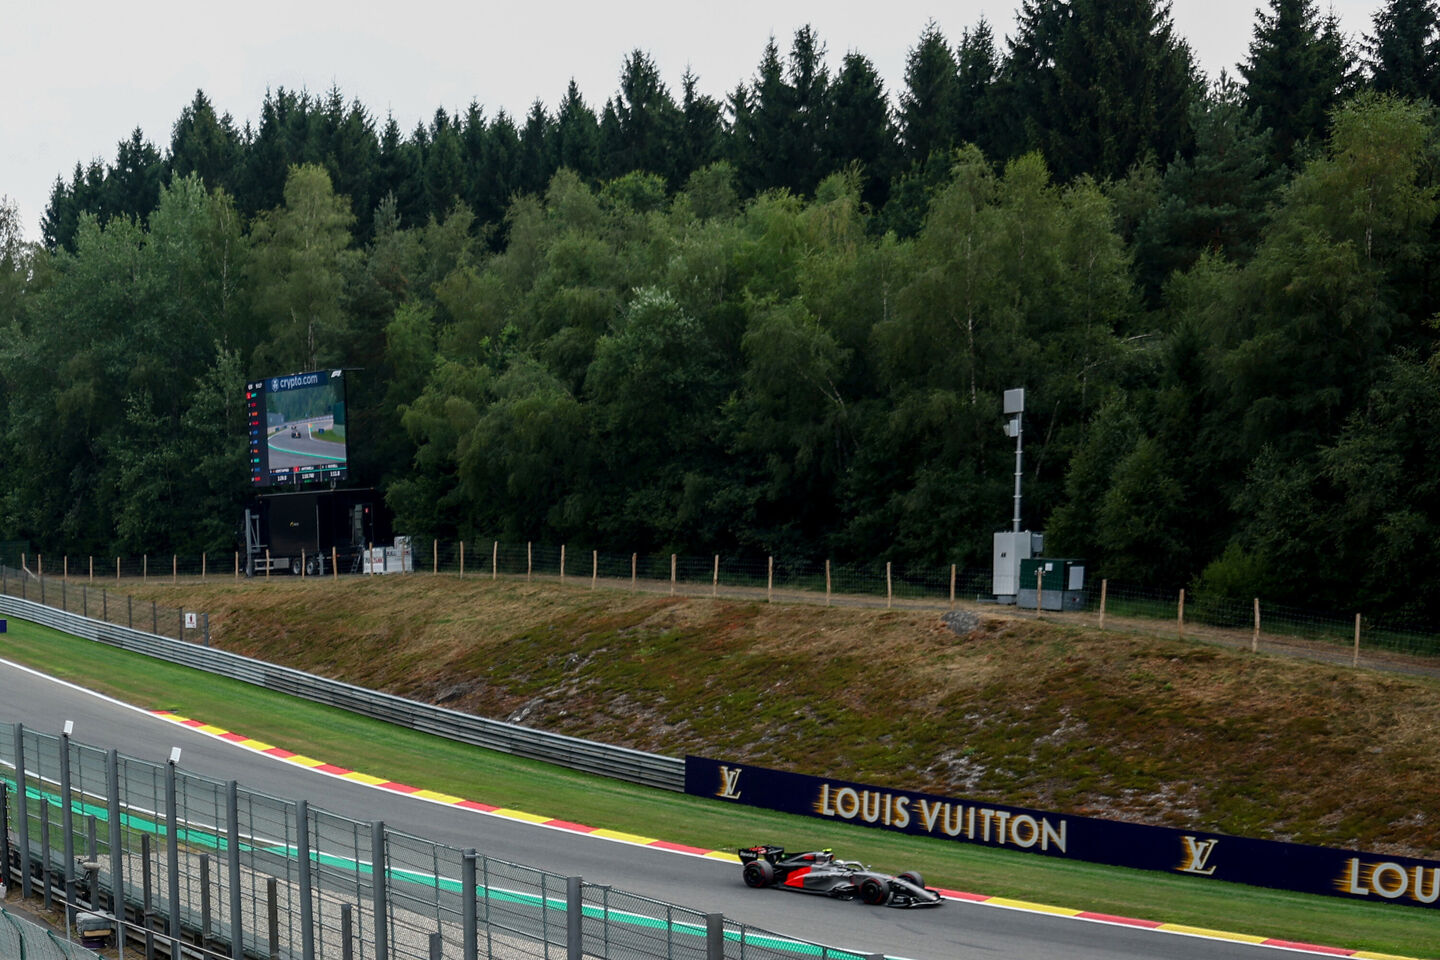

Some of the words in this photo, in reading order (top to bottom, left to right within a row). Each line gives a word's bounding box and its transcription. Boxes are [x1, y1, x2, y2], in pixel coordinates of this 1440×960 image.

[280, 374, 318, 390] crypto.com
[822, 783, 911, 829] LOUIS
[920, 799, 1067, 855] VUITTON
[1350, 858, 1440, 904] LOU
